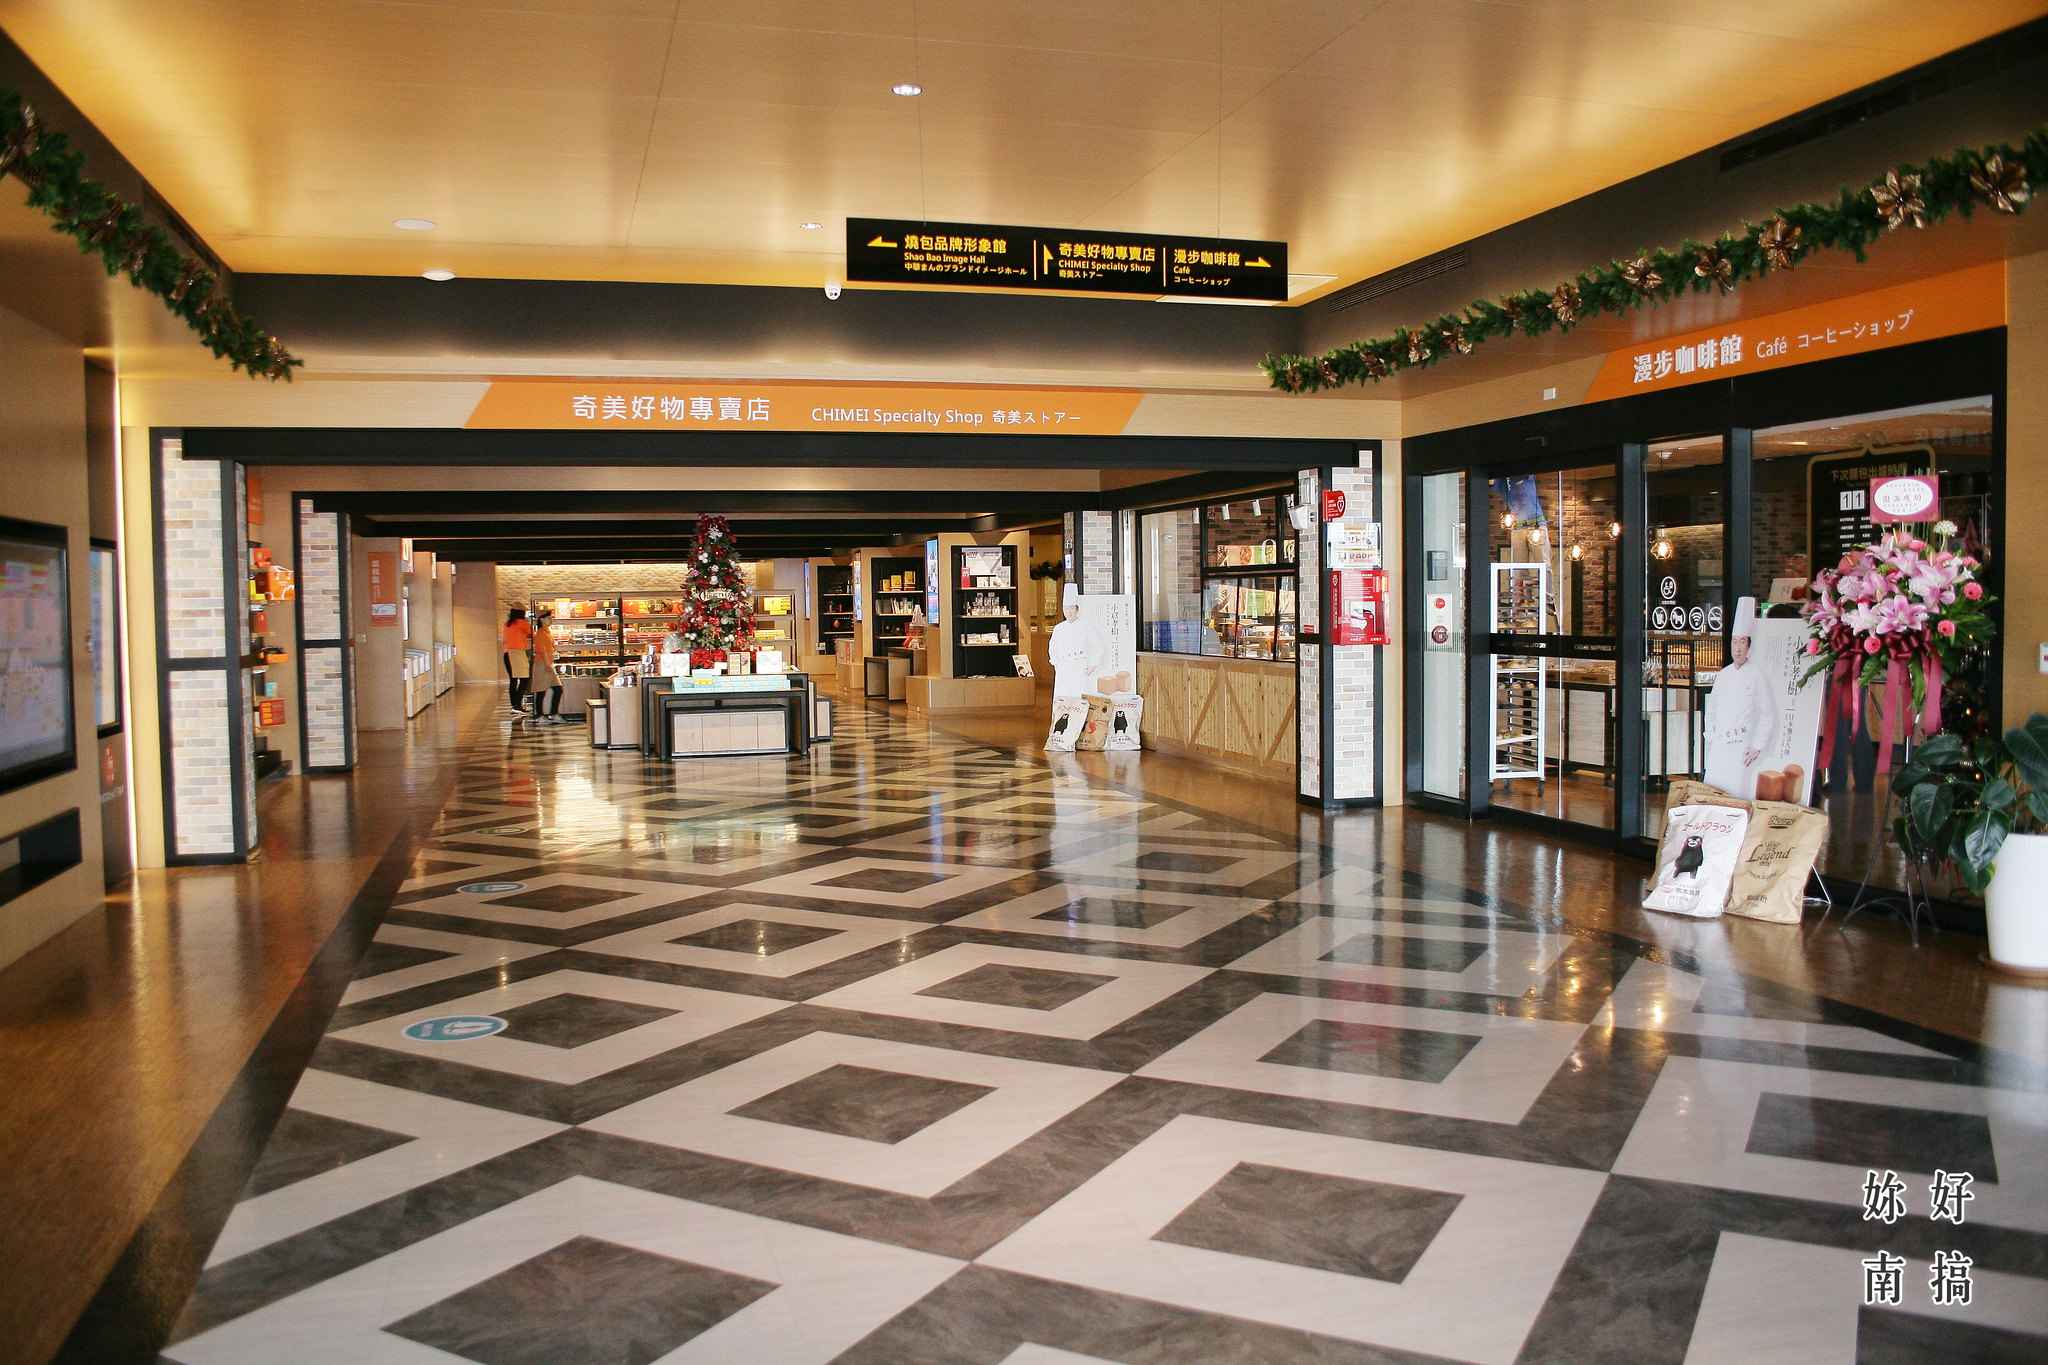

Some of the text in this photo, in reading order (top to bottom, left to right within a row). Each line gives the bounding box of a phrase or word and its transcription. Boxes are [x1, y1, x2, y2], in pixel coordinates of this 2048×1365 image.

[904, 252, 986, 265] Shao Bao Image Hall
[1059, 242, 1156, 262] 奇美好物專賣店
[1173, 248, 1240, 267] 漫步咖啡館
[1058, 259, 1151, 274] CHIMEI Specialty Shop
[1633, 310, 1913, 383] 漫步咖啡館 Café コーヒーショップ
[572, 395, 1081, 426] 奇美好物專賣店 CHIMEI Specialty Shop 奇美ストアー
